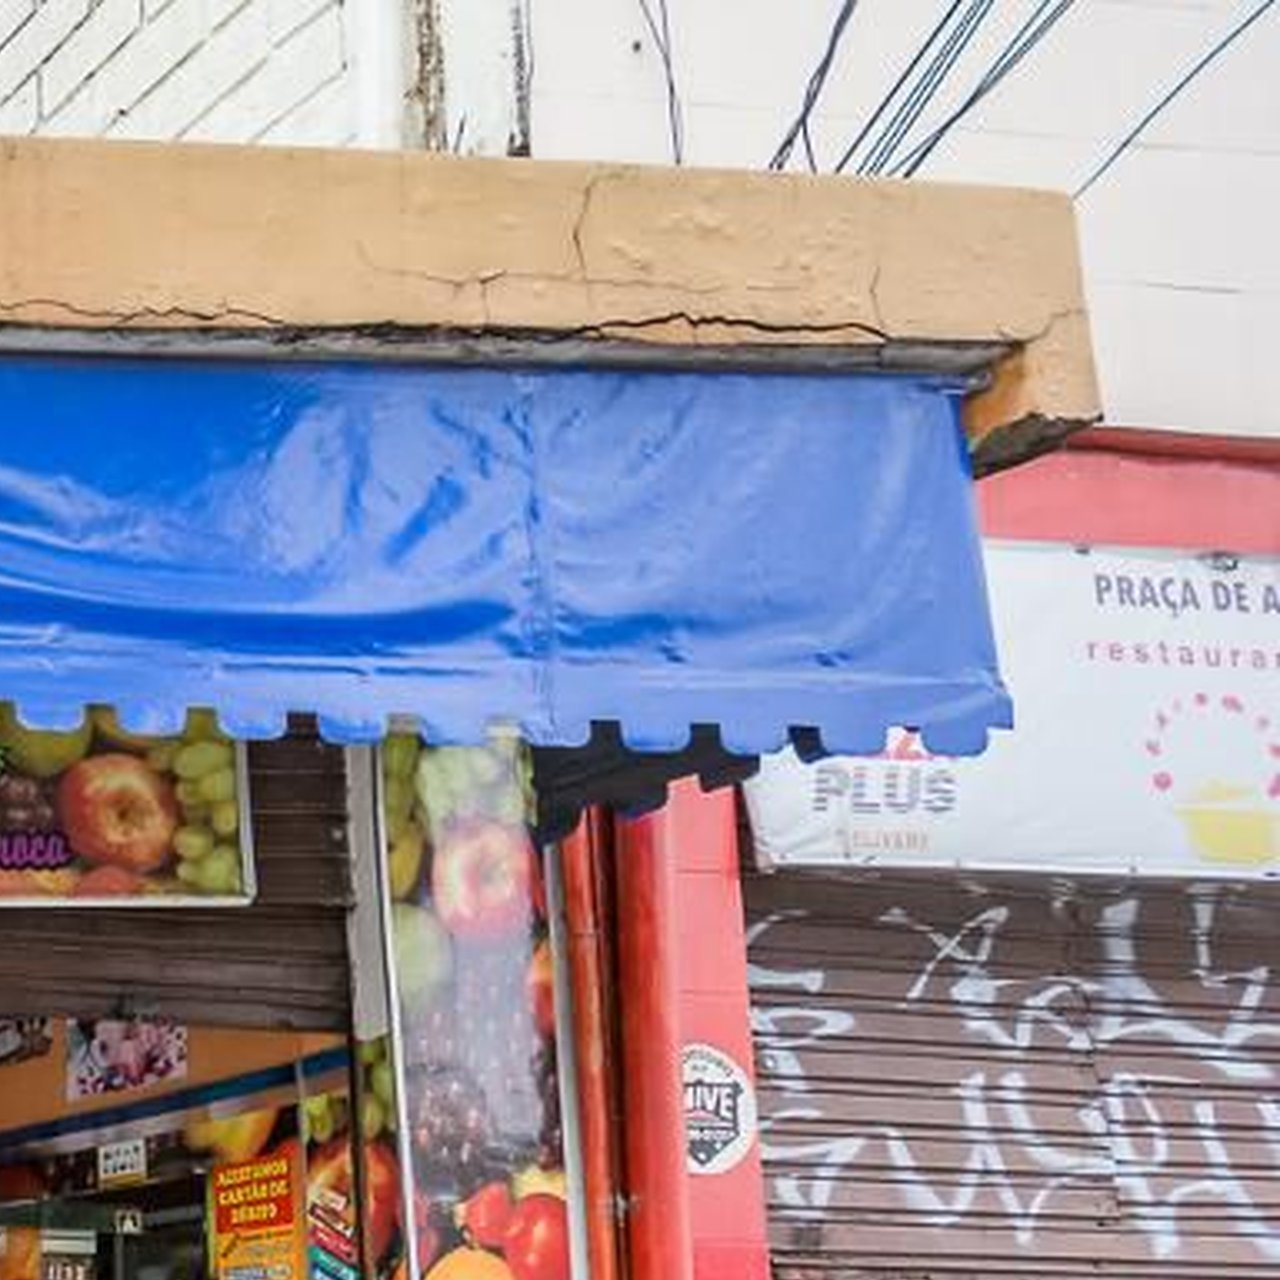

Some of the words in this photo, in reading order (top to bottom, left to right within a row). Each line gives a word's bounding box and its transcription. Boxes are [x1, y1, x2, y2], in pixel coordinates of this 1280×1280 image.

[1094, 575, 1200, 618] PRAÇA
[1211, 580, 1250, 613] DE
[1087, 641, 1280, 669] restaura
[812, 766, 957, 813] PLUS
